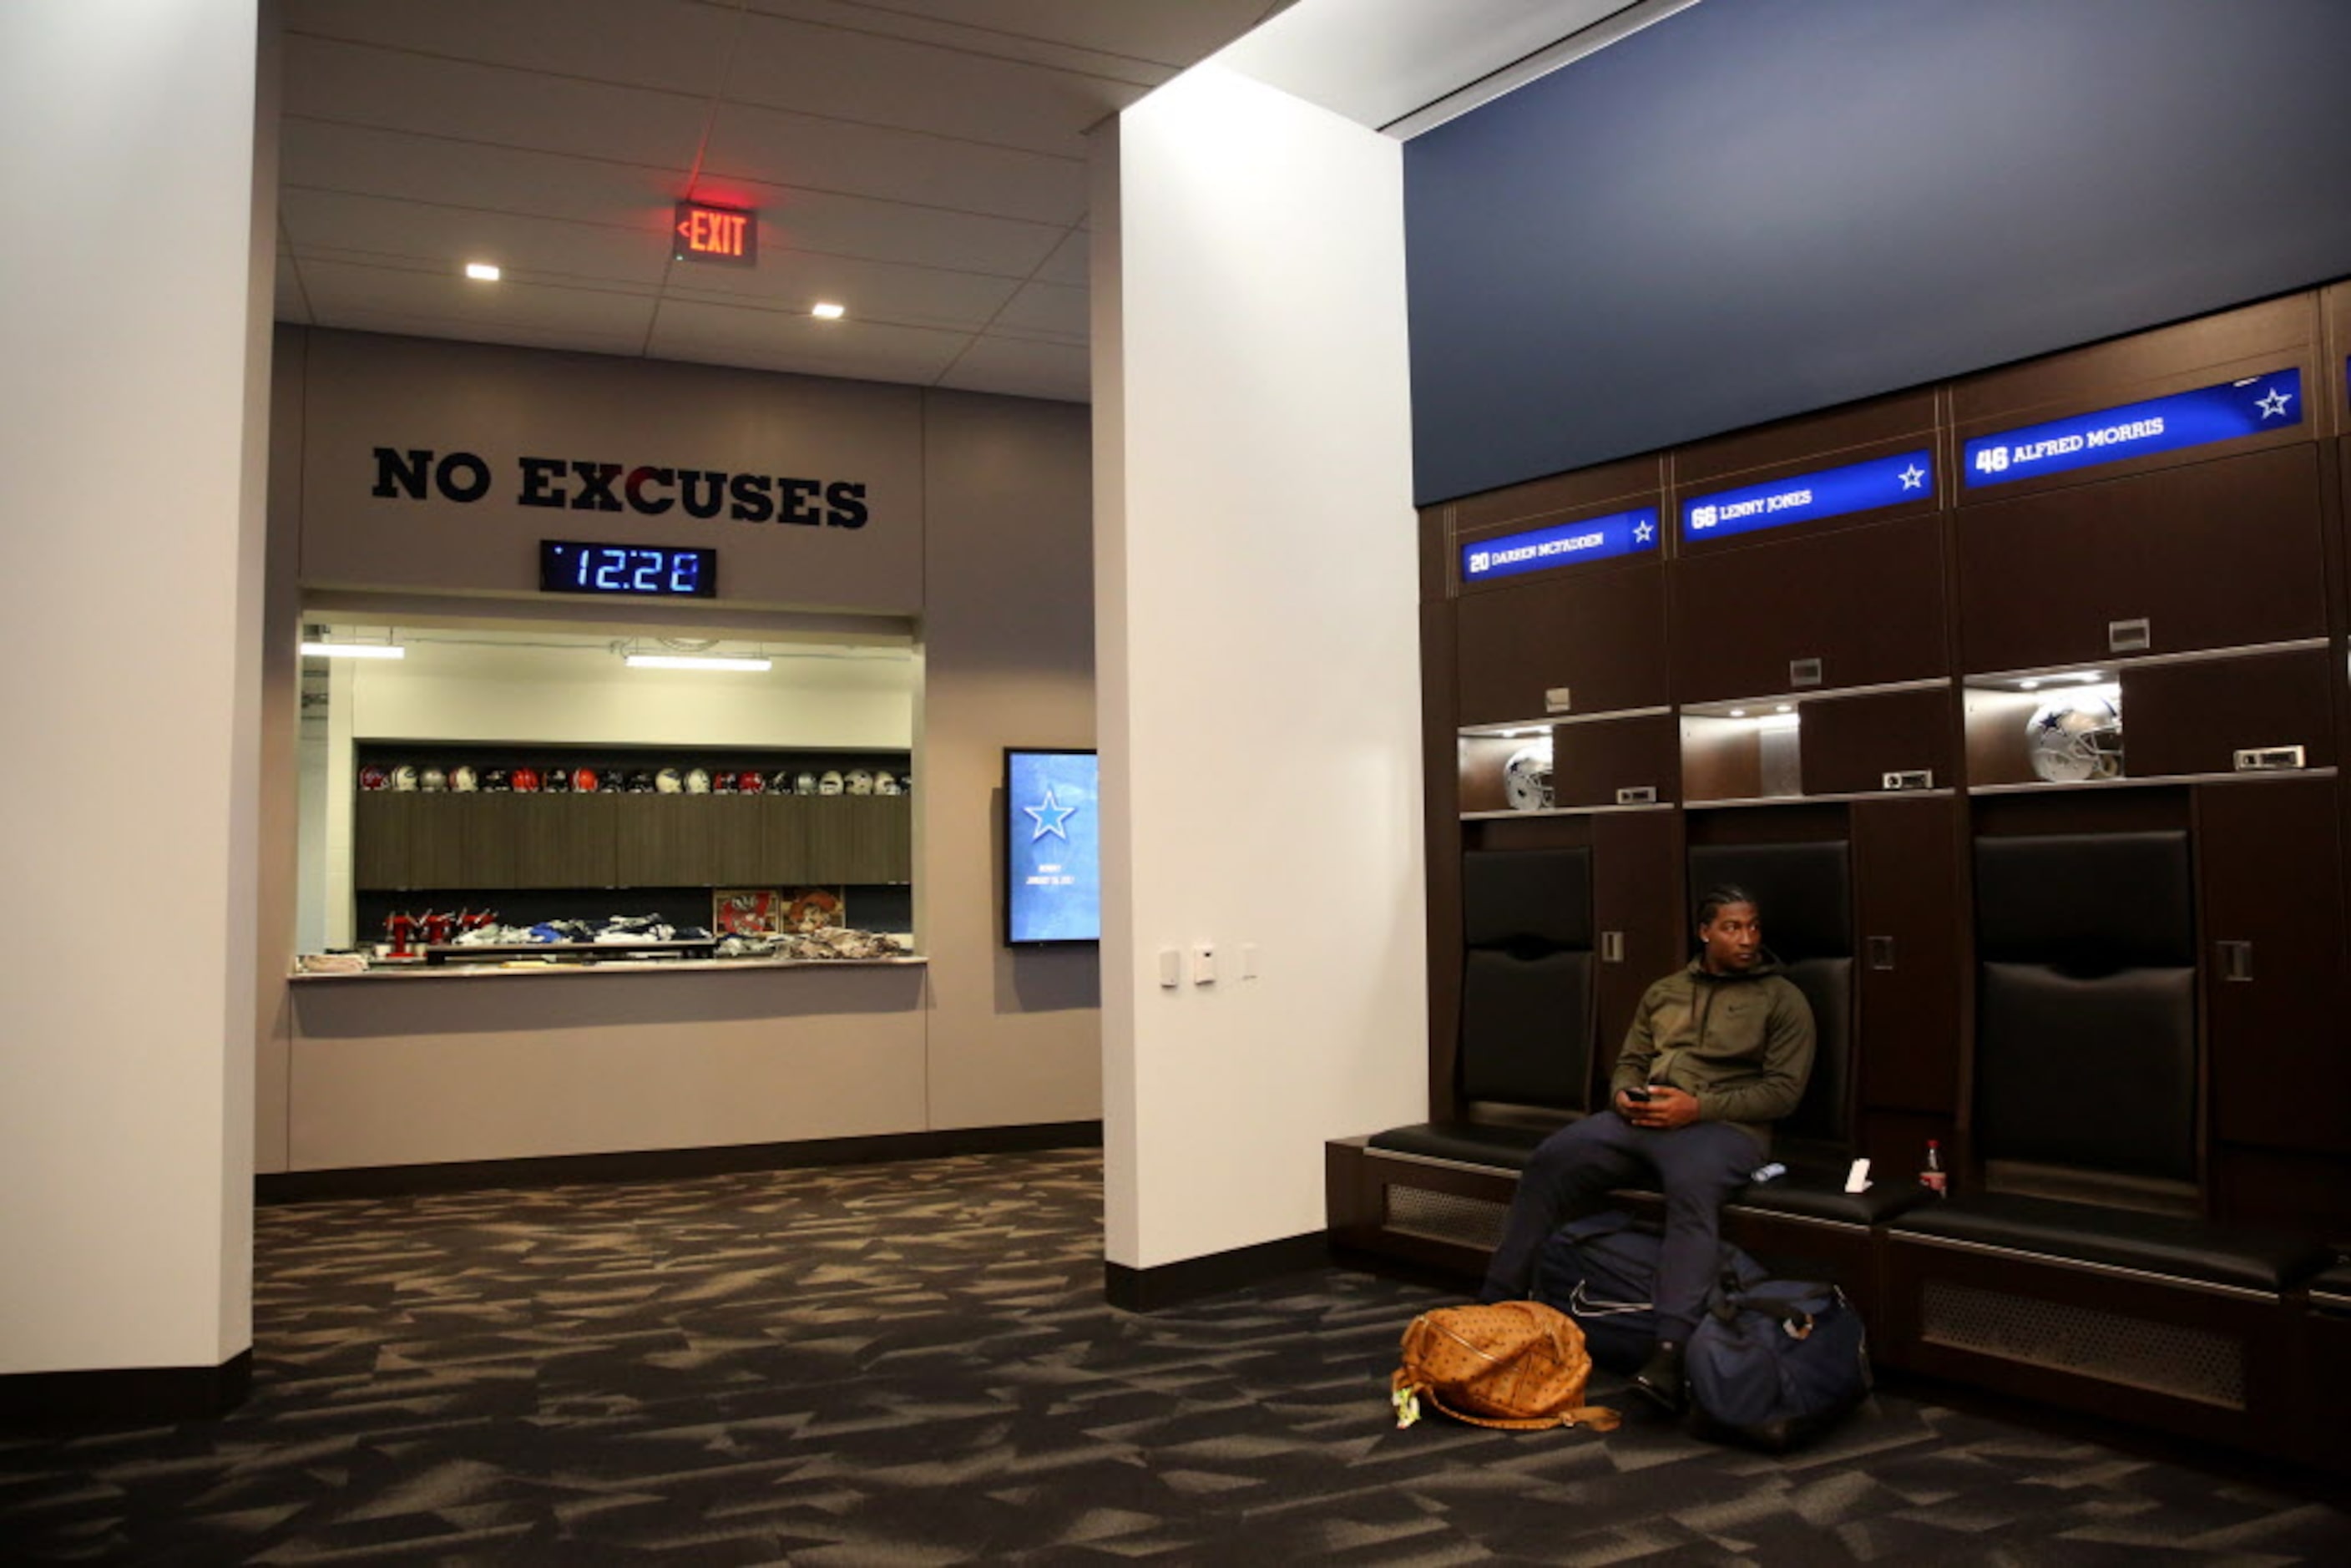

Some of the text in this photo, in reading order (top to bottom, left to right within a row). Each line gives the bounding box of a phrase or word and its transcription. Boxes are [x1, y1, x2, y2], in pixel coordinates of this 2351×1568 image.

[690, 210, 747, 256] EXIT
[1975, 417, 2165, 474] 46 ALFRED MORRIS
[372, 448, 869, 529] NO EXCUSES
[1691, 488, 1813, 529] 66 LENNY JONES
[1469, 552, 1490, 574] 20
